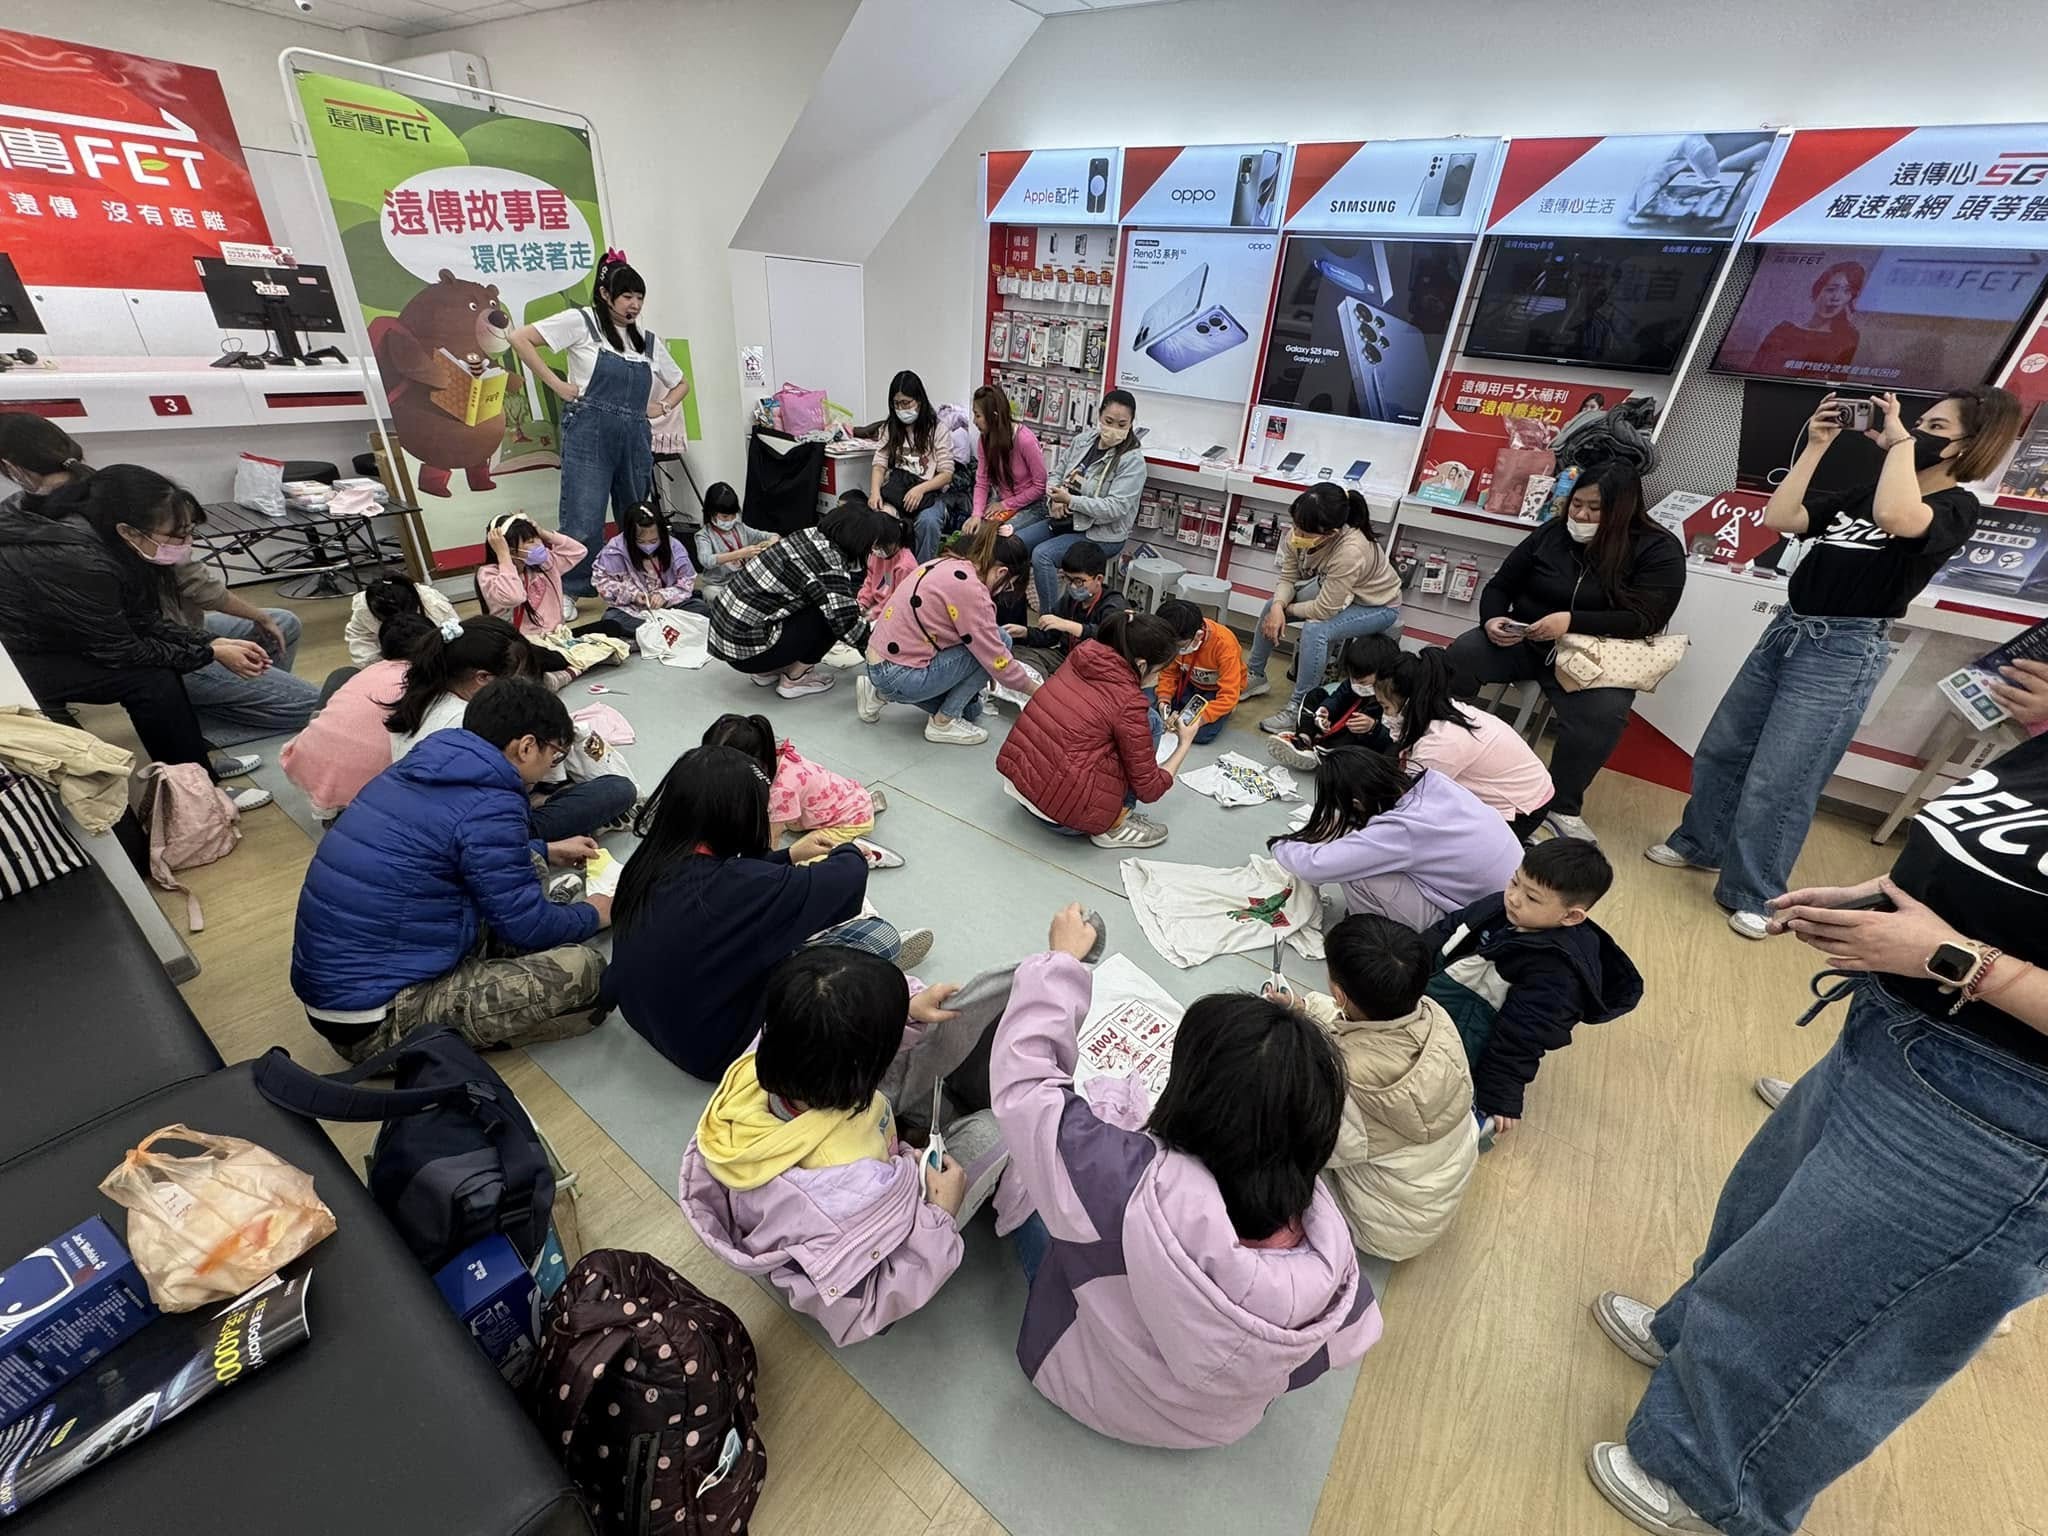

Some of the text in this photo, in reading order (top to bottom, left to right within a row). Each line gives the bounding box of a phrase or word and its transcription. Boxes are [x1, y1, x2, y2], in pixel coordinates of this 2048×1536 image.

[1023, 187, 1080, 205] Apple配件
[383, 188, 571, 237] 遠傳故事屋
[1330, 200, 1397, 213] SAMSUNG
[1538, 197, 1617, 214] 遠傳心生活
[470, 240, 595, 275] 環保袋著走
[1133, 248, 1162, 259] Reno13
[1163, 248, 1180, 260] 系列
[1285, 344, 1340, 357] Galaxy S25 Ultra
[1293, 355, 1314, 364] Galaxy
[1460, 379, 1570, 403] 遠傳用戶5大福利
[165, 398, 180, 414] 3
[1714, 547, 1737, 559] LTE
[1087, 1026, 1118, 1057] POOH
[247, 1322, 264, 1366] Galaxy
